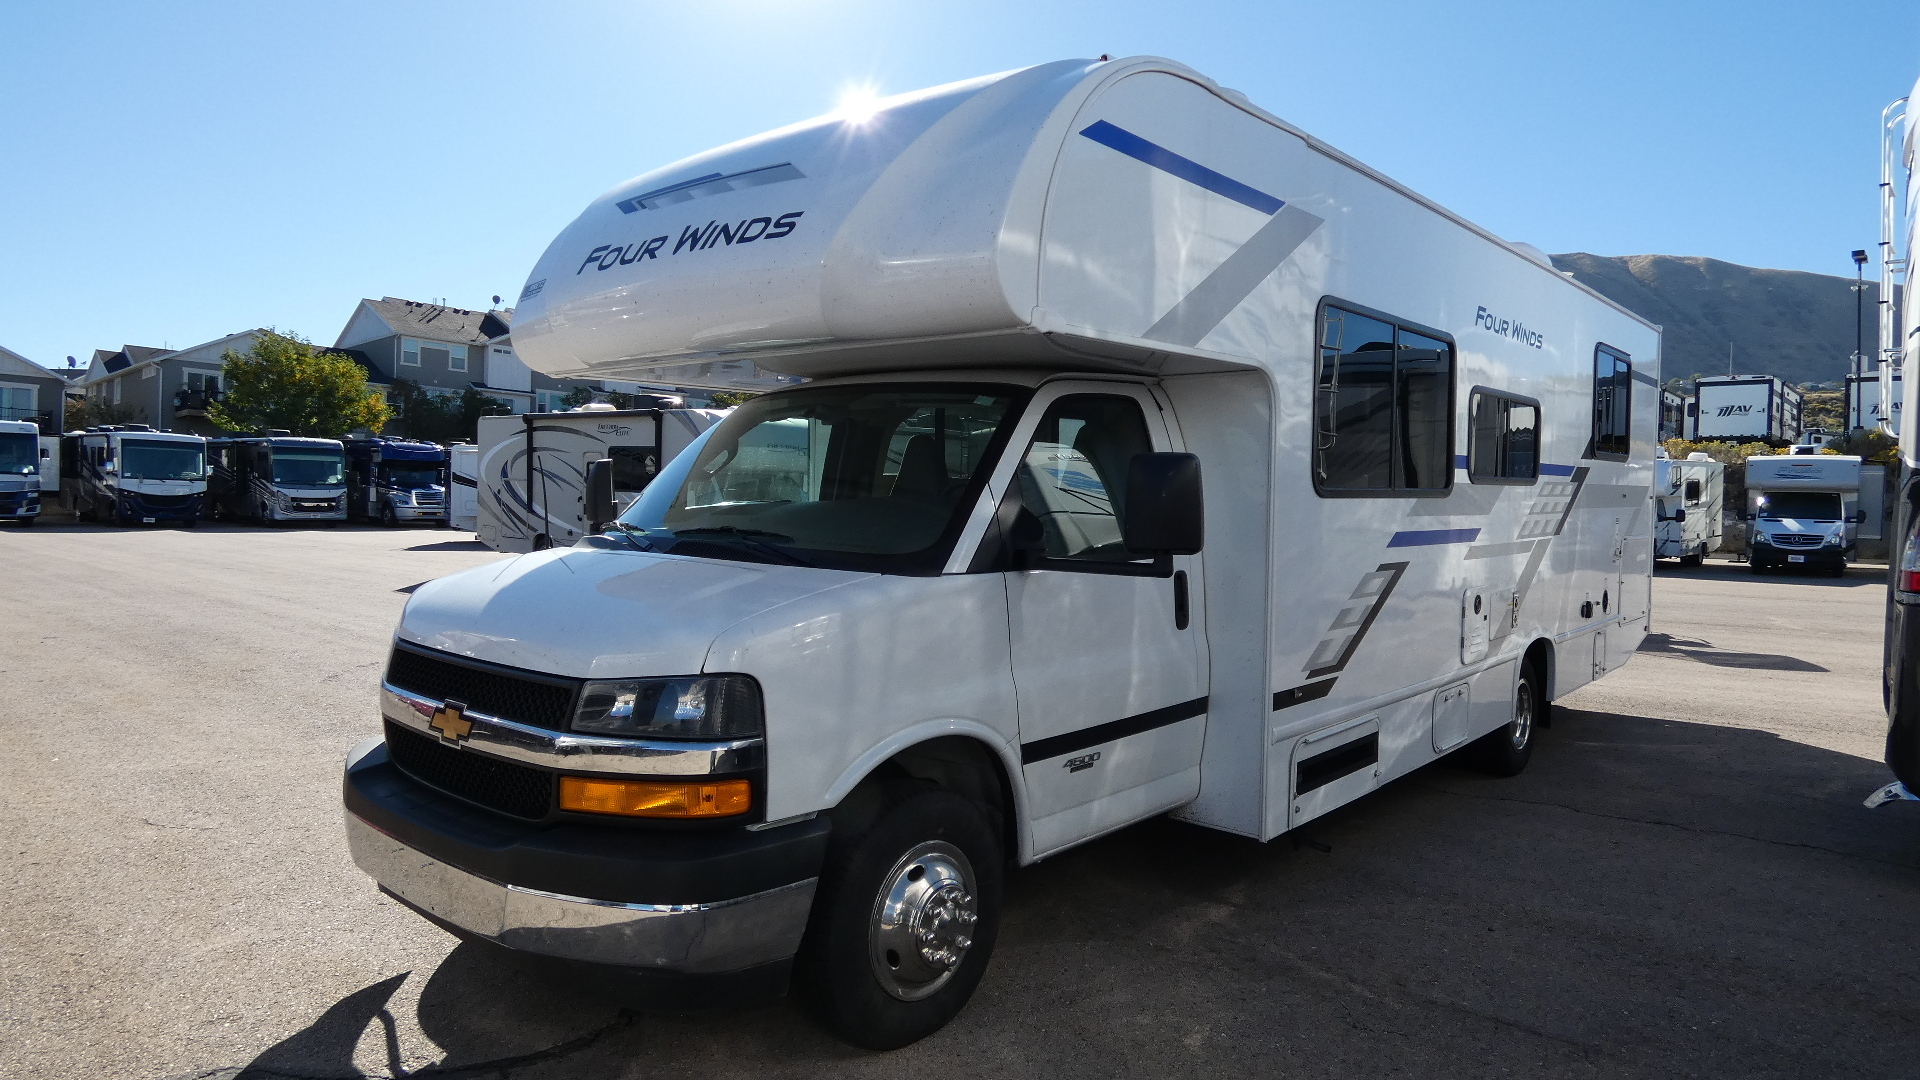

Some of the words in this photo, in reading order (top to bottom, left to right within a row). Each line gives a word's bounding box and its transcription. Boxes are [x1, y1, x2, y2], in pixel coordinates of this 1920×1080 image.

[576, 235, 669, 276] FOUR
[673, 211, 804, 257] WINDS
[1475, 305, 1509, 337] FOUR
[1512, 320, 1543, 349] WINDS
[1062, 752, 1101, 769] 4500
